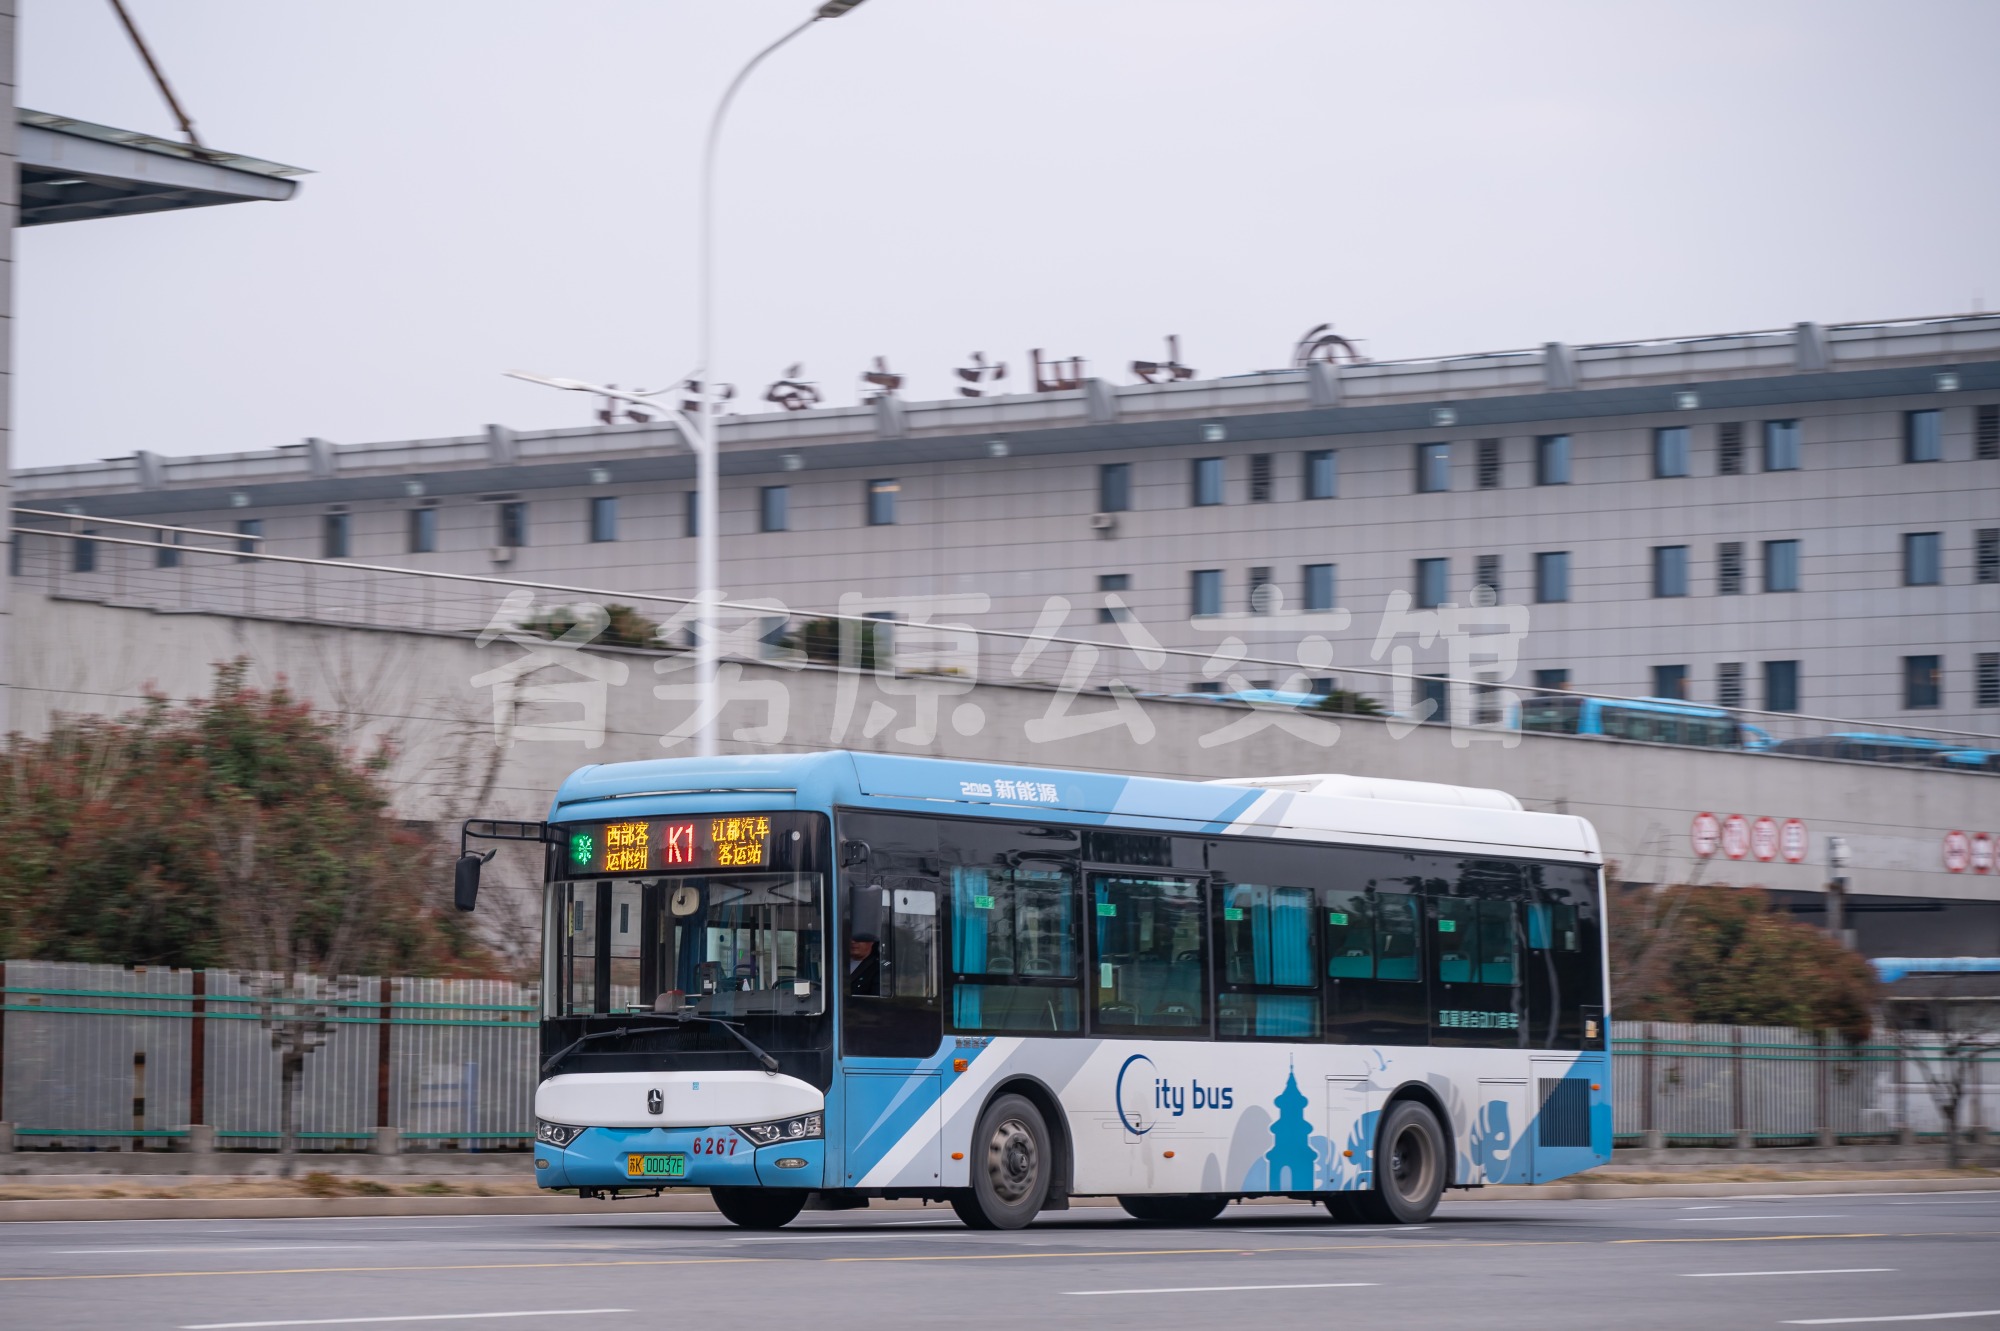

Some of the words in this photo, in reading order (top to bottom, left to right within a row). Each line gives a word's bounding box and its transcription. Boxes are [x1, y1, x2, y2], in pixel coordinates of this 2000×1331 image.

[994, 779, 1060, 803] 新能源
[606, 821, 650, 847] 西部客
[712, 816, 770, 842] 江都汽车
[668, 824, 695, 863] K1
[718, 839, 763, 866] 客运站
[605, 845, 650, 872] 运枢纽
[1192, 1079, 1233, 1109] bus
[693, 1136, 738, 1156] 6267
